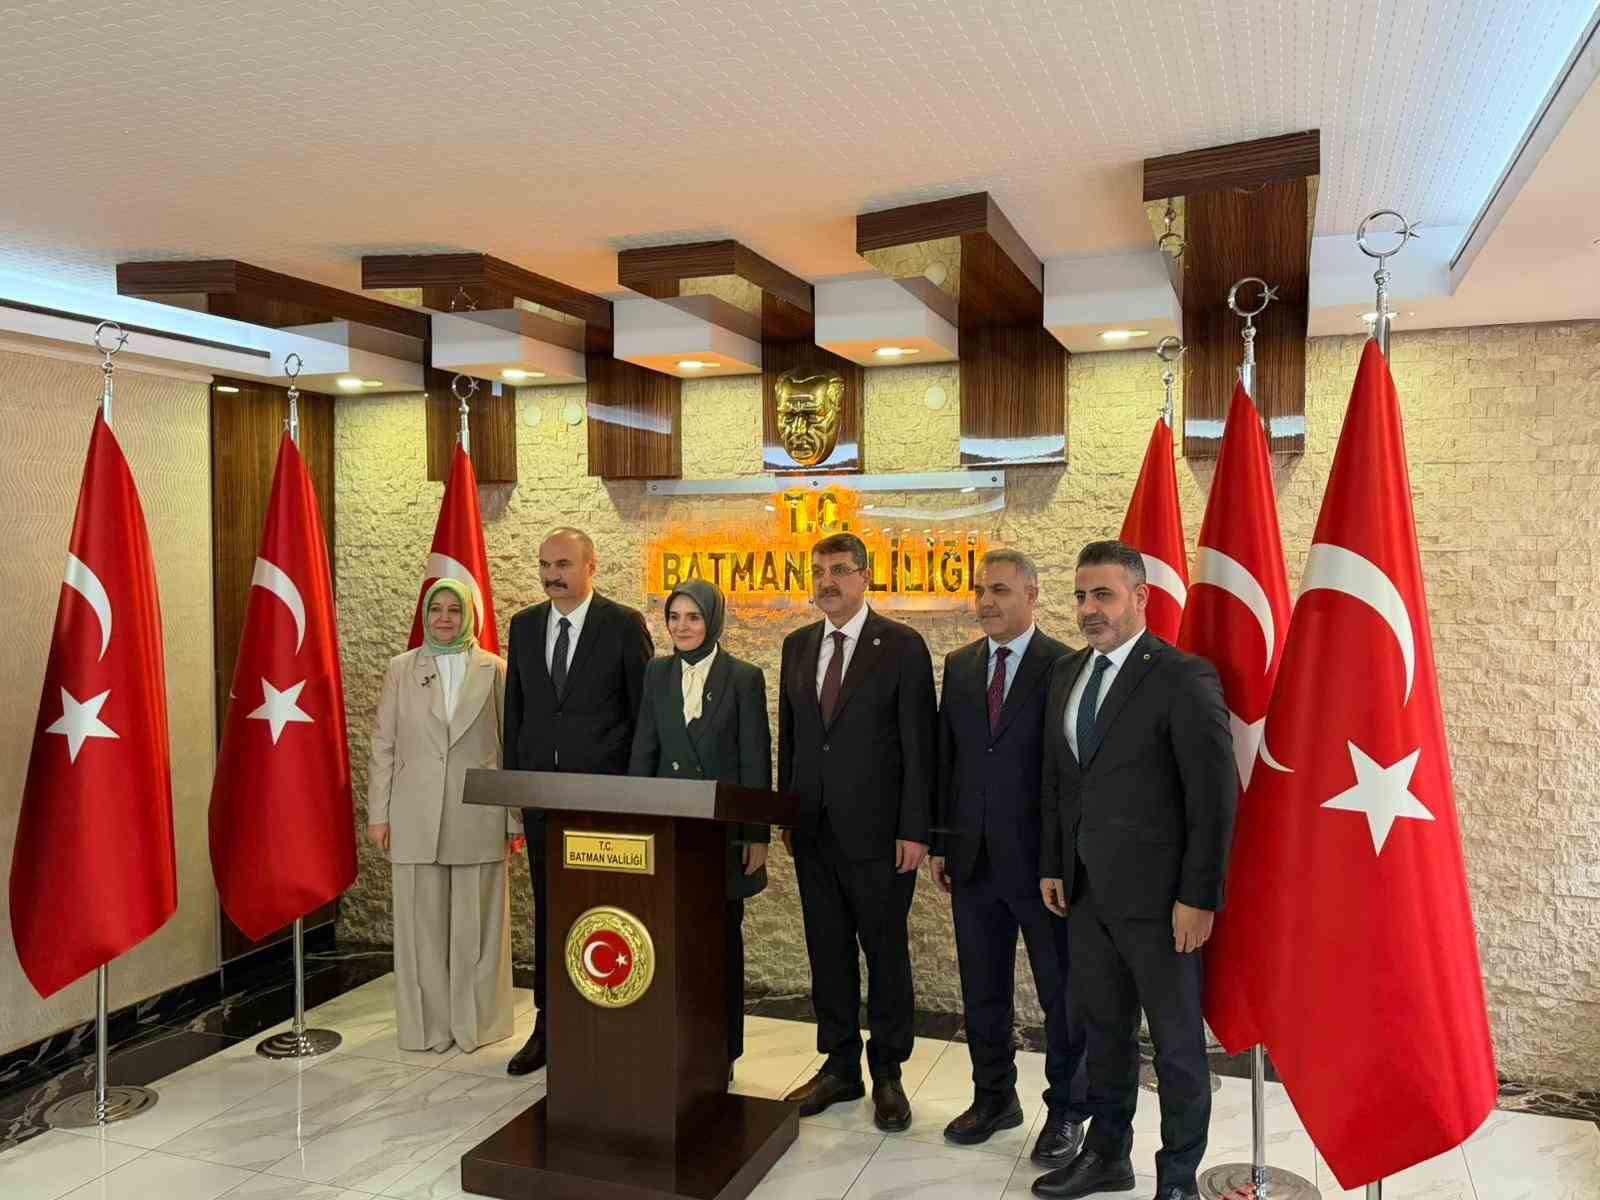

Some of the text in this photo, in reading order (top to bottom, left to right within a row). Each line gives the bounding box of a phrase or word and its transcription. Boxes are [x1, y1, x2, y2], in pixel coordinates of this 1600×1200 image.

[783, 492, 849, 534] T.C.
[663, 535, 975, 592] BATMAN LİLİĞİ
[569, 851, 643, 866] BATMAN VALİLİĞİ
[598, 840, 614, 851] T.C.
